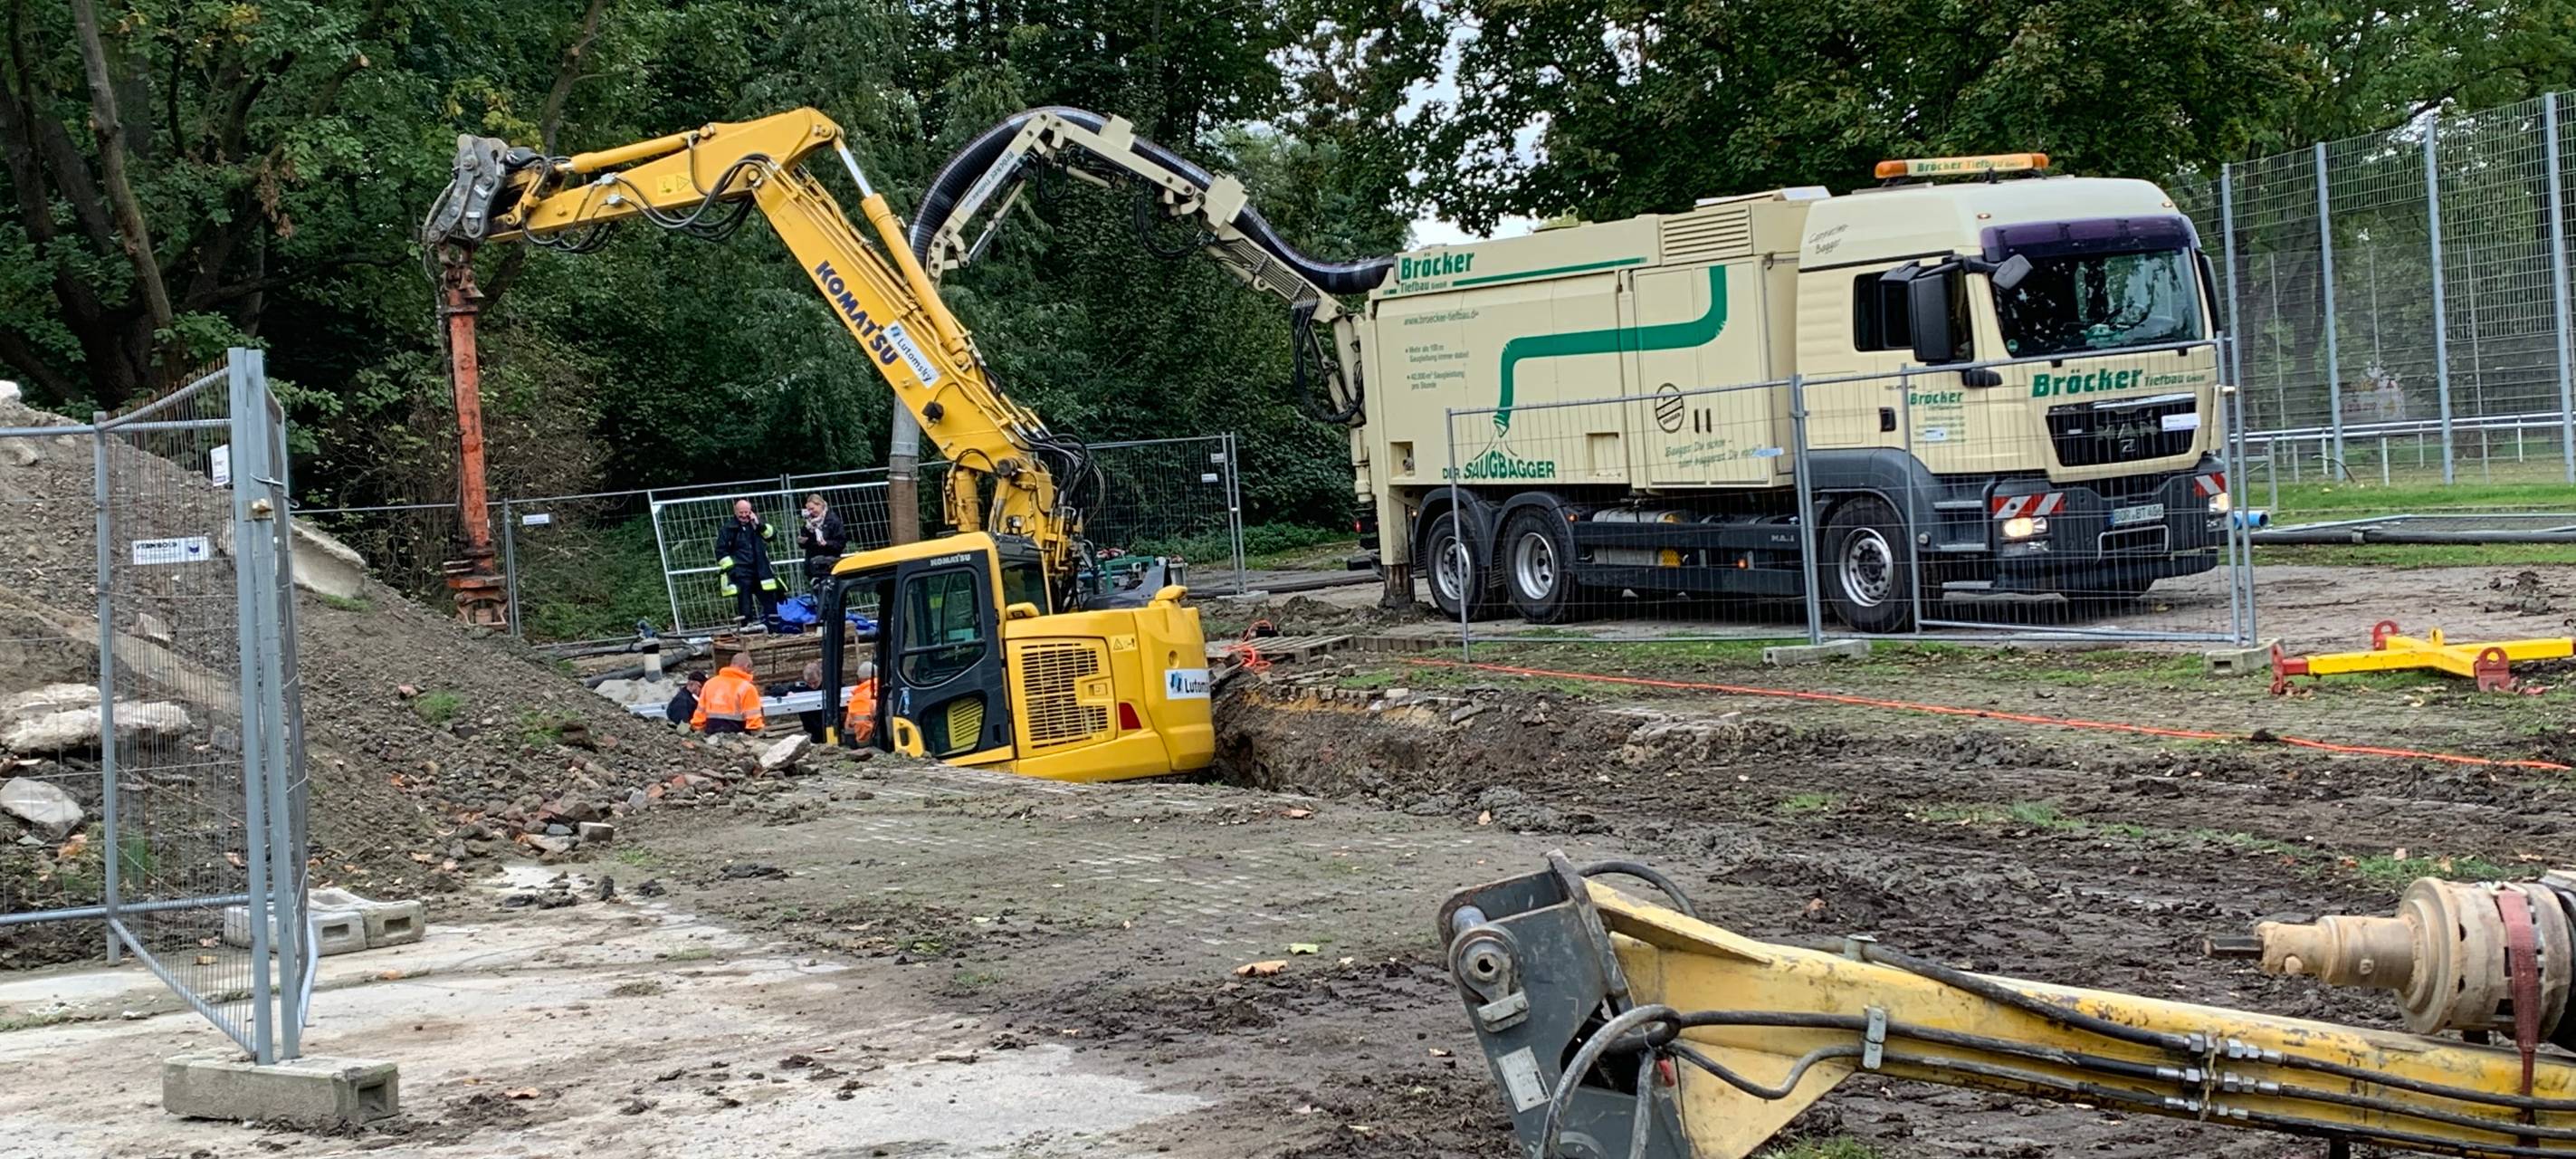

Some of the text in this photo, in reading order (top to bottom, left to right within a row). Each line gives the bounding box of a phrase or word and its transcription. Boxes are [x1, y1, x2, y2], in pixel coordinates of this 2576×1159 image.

[1916, 161, 1961, 172] Bröcker
[1965, 158, 2004, 169] Tiefbau
[1401, 252, 1474, 280] Bröcker
[1401, 281, 1430, 293] Tiefbau
[815, 260, 899, 366] KOMATSU
[897, 338, 932, 382] Lutomsky
[2032, 368, 2143, 398] Bröcker
[2144, 374, 2183, 387] Tiefbau
[1910, 391, 1963, 406] Bröcker
[1464, 450, 1556, 479] SAUGBAGGER
[930, 553, 971, 567] KOMATSU
